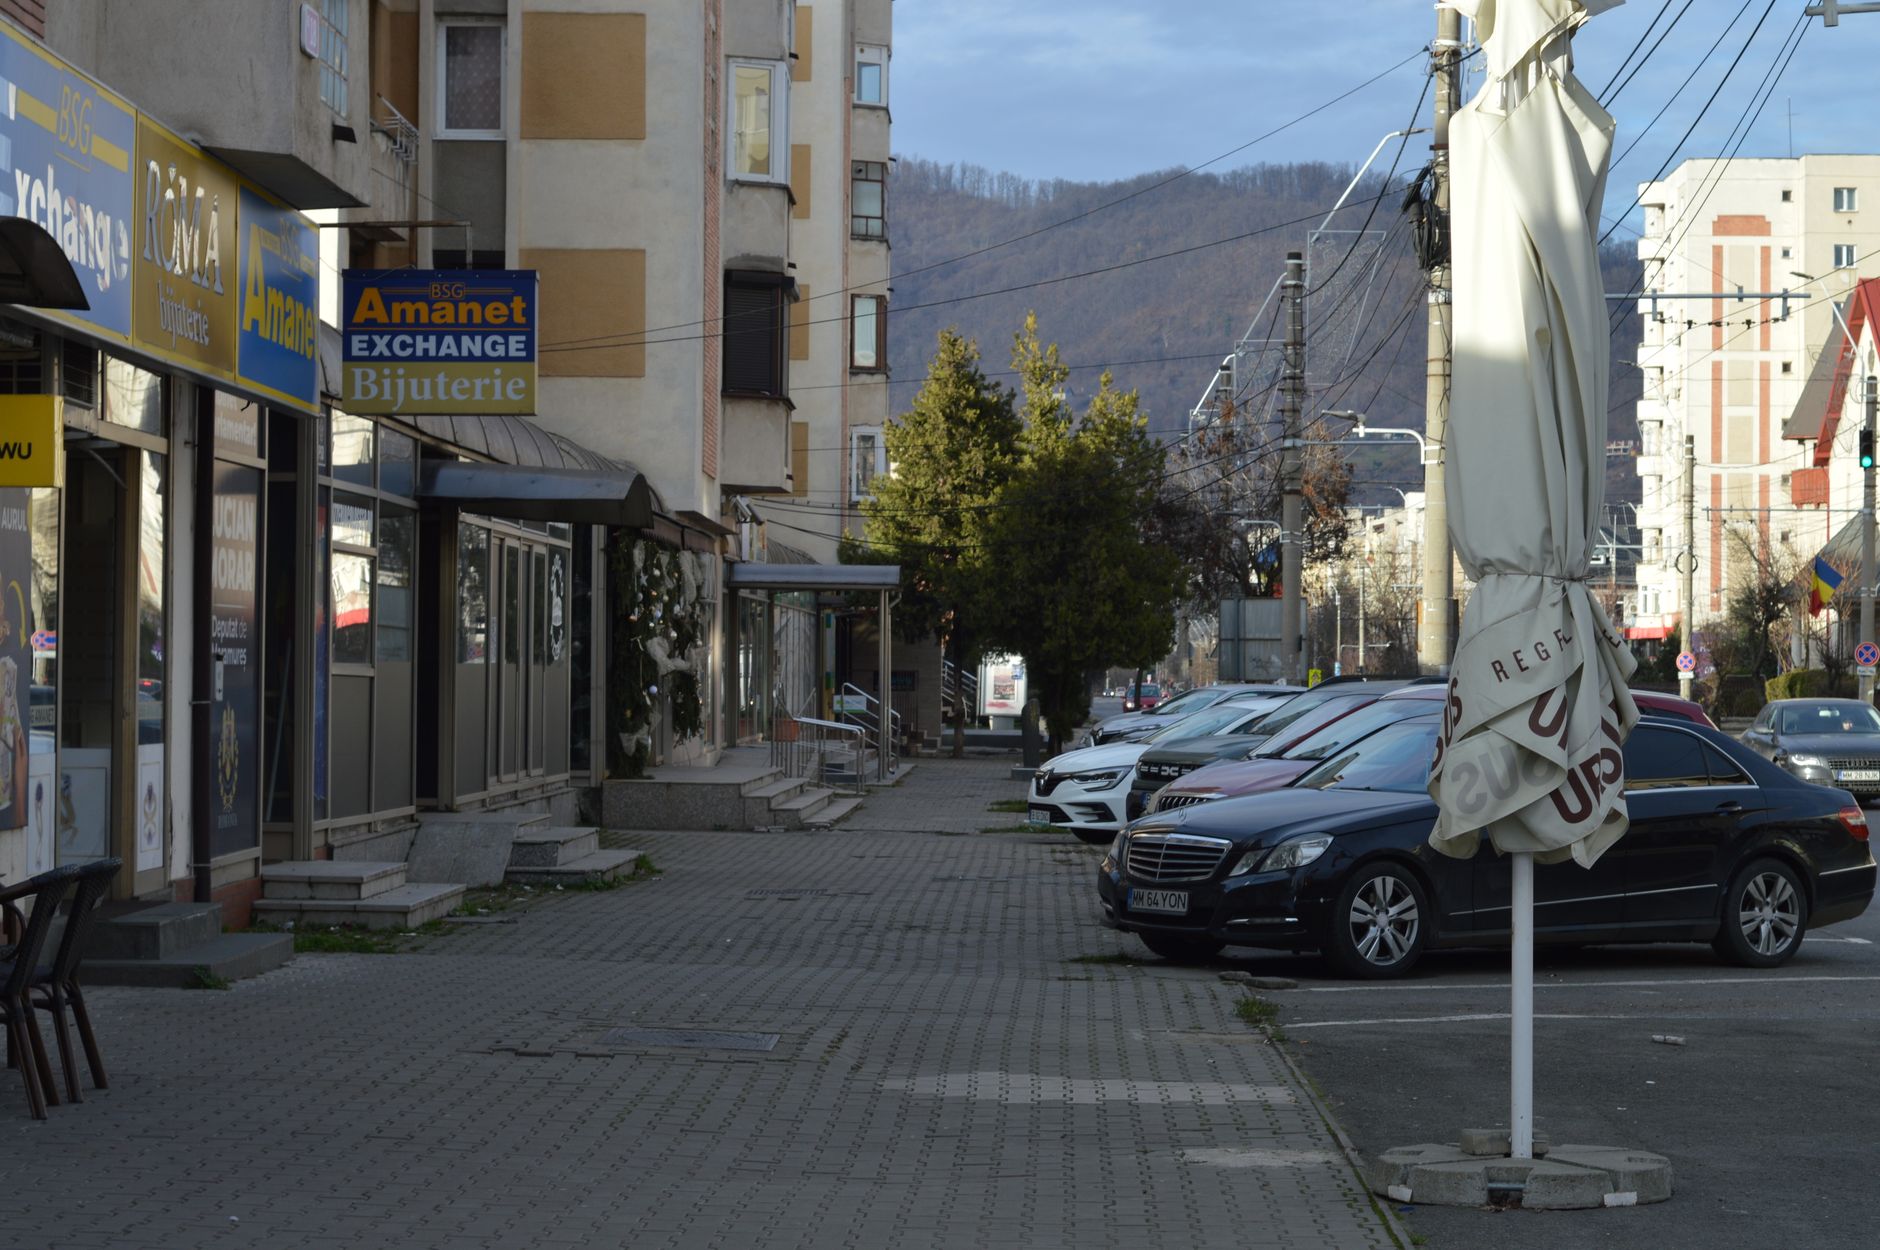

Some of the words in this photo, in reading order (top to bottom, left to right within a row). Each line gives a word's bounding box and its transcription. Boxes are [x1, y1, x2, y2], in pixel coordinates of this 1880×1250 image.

[58, 84, 92, 154] BSG
[352, 287, 526, 325] Amanet
[431, 284, 464, 299] BSG
[158, 280, 209, 350] bijuterie
[351, 335, 527, 357] EXCHANGE
[351, 368, 526, 412] Bijuterie
[1, 507, 28, 532] AURUL
[212, 496, 254, 542] UCIAN
[211, 616, 238, 642] Deputat
[239, 619, 248, 639] de
[1132, 890, 1145, 906] MM
[1147, 892, 1159, 907] 64
[1161, 892, 1187, 909] YON
